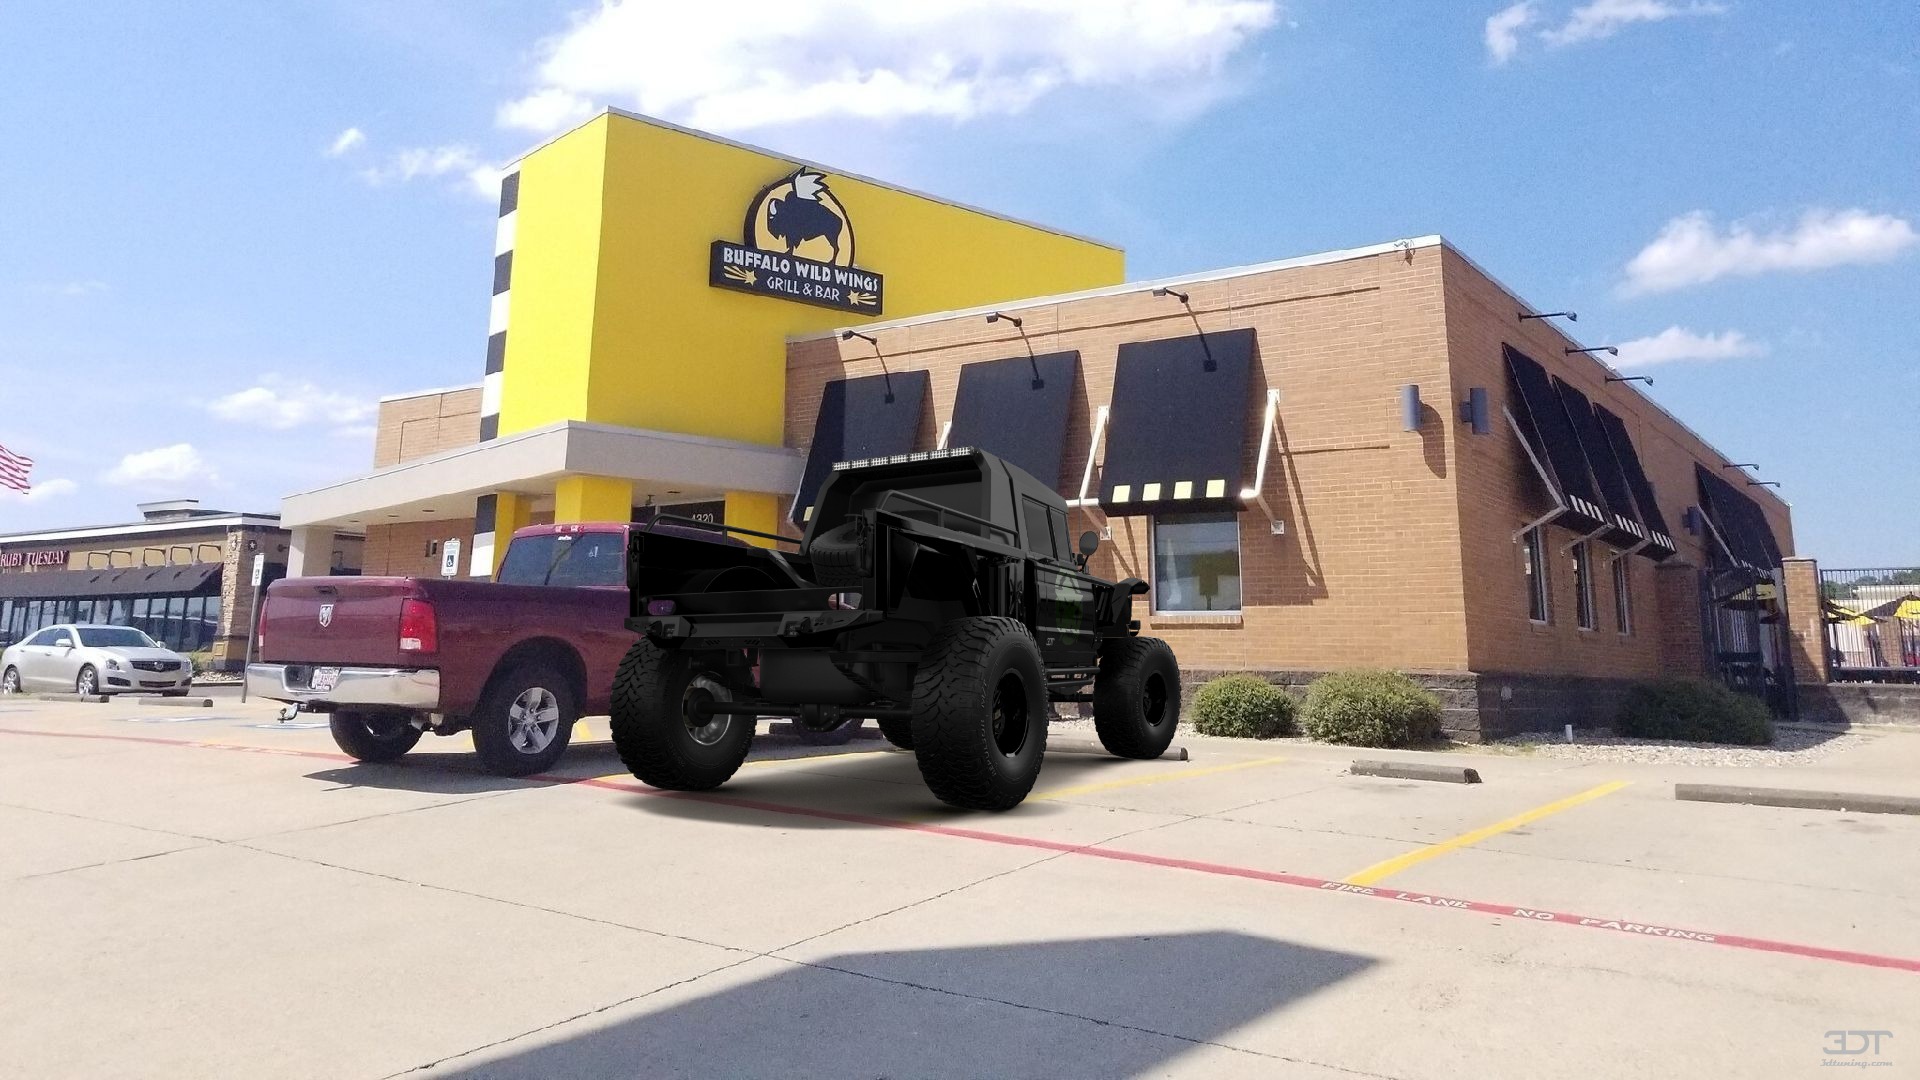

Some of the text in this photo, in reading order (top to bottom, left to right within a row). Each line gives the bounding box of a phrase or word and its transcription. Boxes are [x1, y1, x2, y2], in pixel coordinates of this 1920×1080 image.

[723, 247, 878, 292] BUFFALO WILD WINGS
[766, 276, 840, 302] GRILL & BAR
[0, 550, 66, 567] RUBY TUESDAY
[1320, 881, 1716, 943] FIRE LANE NO PARKING
